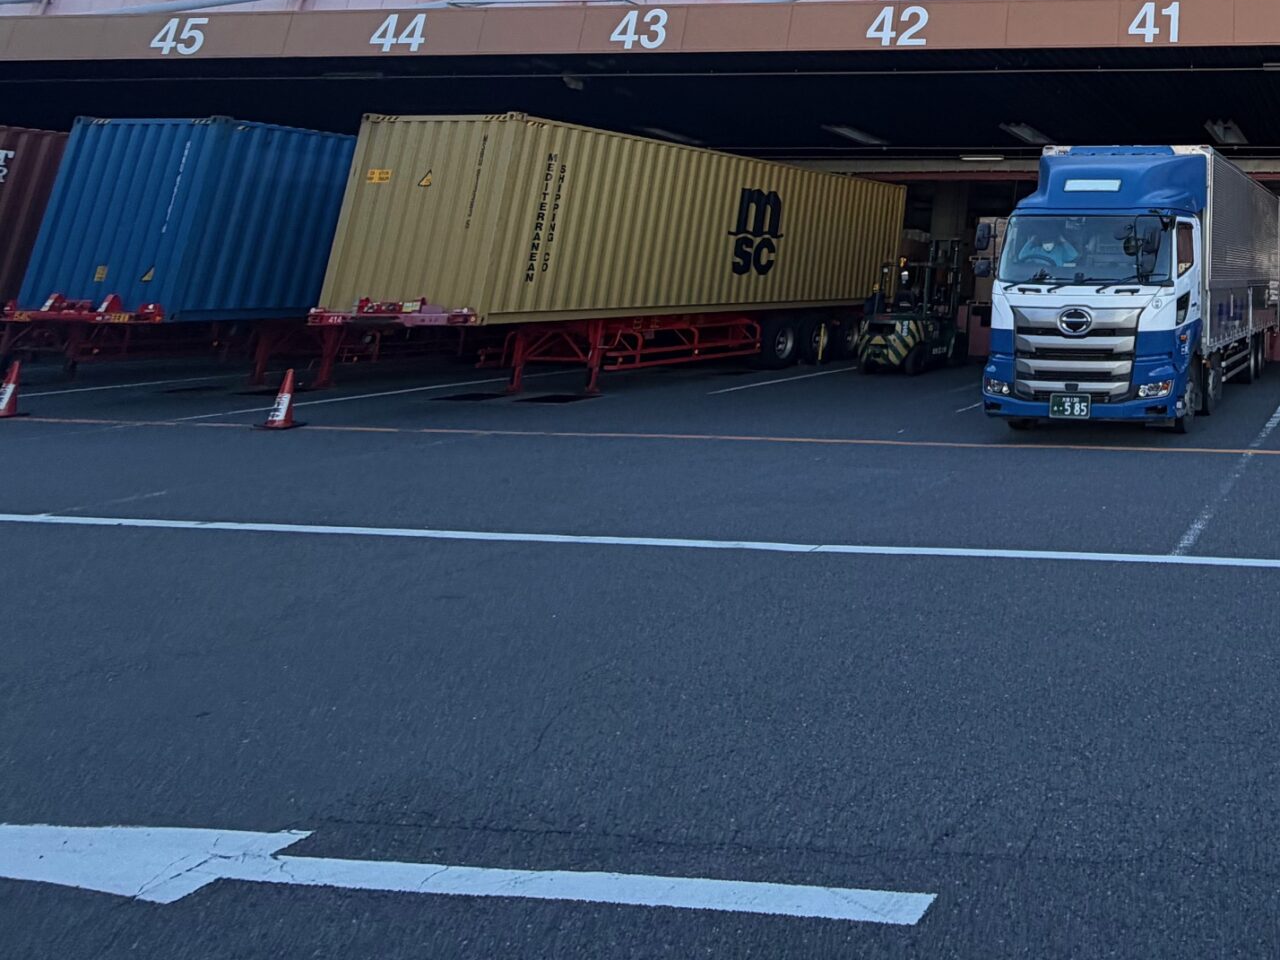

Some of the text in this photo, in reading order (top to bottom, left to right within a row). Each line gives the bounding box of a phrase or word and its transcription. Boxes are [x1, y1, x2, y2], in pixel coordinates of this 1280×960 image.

[150, 17, 209, 55] 45
[369, 13, 427, 52] 44
[609, 8, 668, 50] 43
[865, 5, 930, 47] 42
[1127, 1, 1180, 43] 41
[525, 153, 558, 282] MEDITERRANEAN
[541, 164, 567, 272] SHIPPING CO
